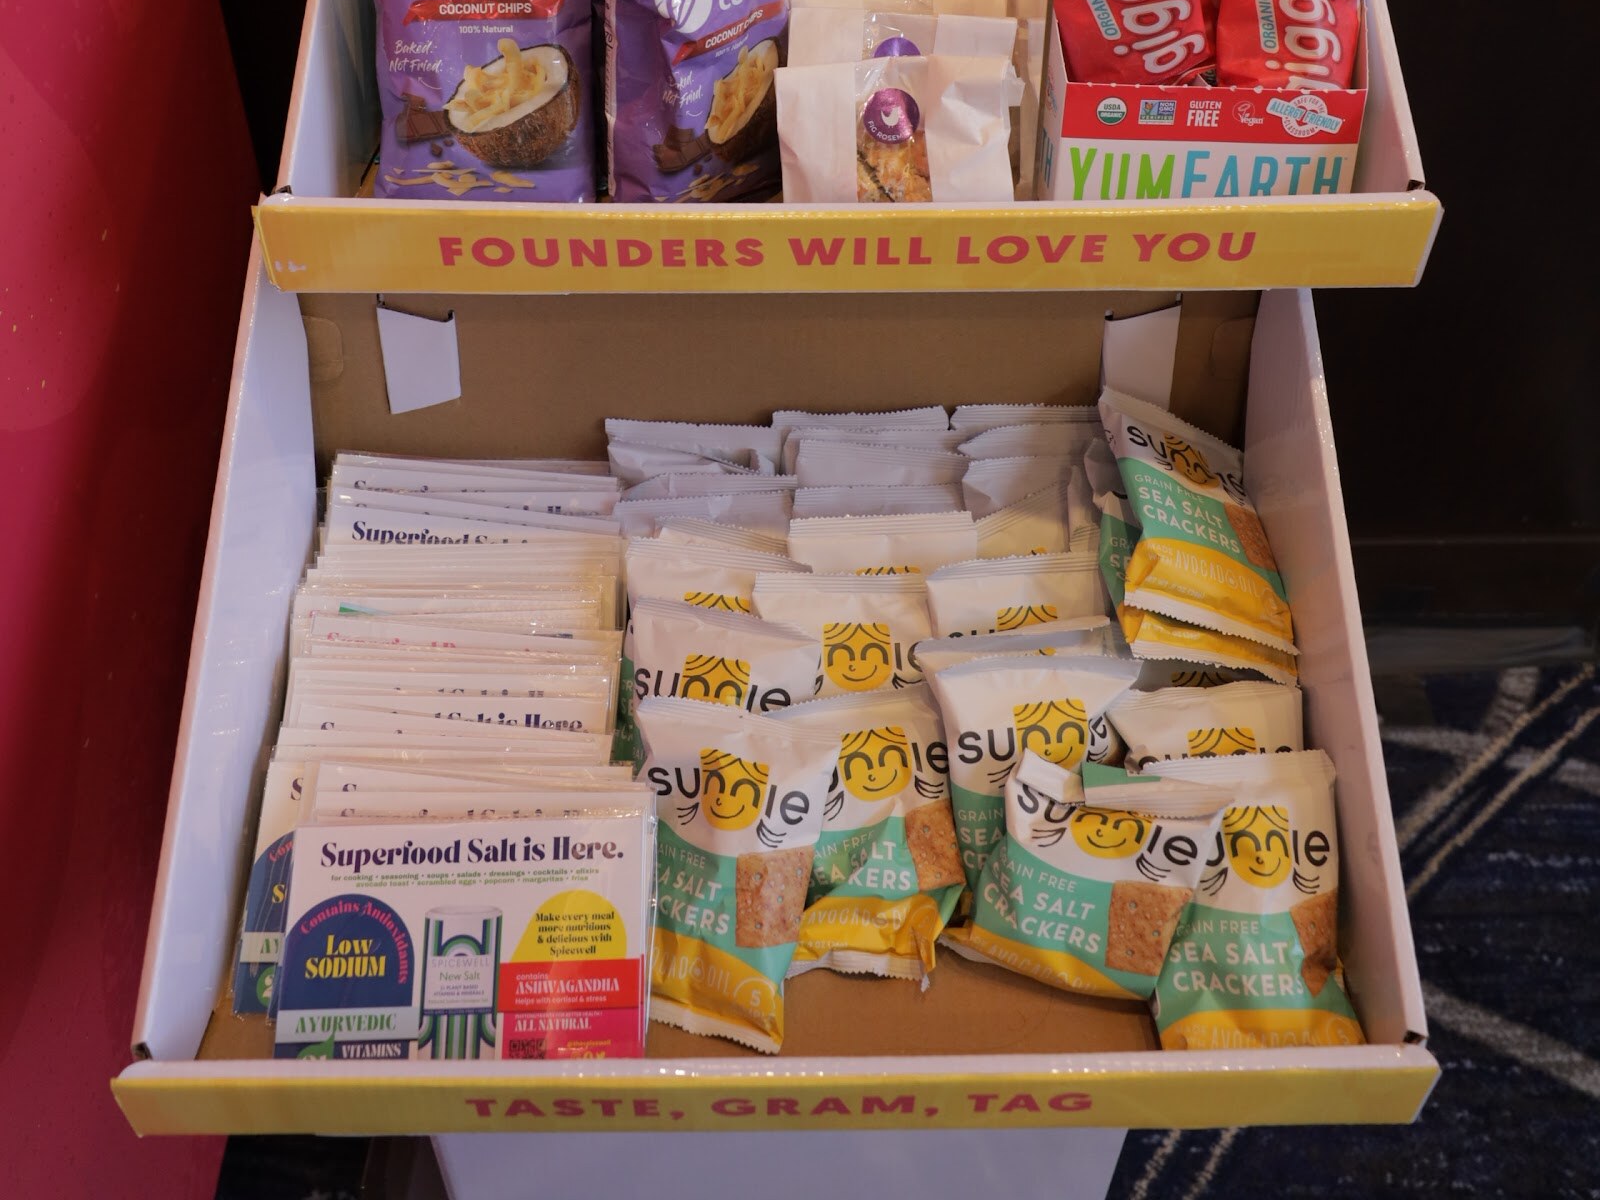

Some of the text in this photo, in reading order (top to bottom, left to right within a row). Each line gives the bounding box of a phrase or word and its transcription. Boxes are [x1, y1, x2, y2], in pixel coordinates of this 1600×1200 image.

[438, 3, 532, 15] COCONUT CHIPS
[459, 25, 514, 34] 100% Natural
[705, 24, 743, 49] COCONUT
[389, 59, 410, 72] Not
[1189, 100, 1222, 110] GLUTEN
[1186, 109, 1220, 127] FREE
[1269, 101, 1340, 131] ALLERGY FRIENDLY
[867, 120, 878, 133] FIG
[1069, 147, 1343, 201] YUMEARTH
[438, 231, 1257, 268] FOUNDERS WILL LOVE YOU
[1134, 474, 1172, 492] GRAIN
[1138, 486, 1223, 529] SEA SALT
[1142, 504, 1241, 554] CRACKERS
[647, 766, 811, 826] sunnie
[957, 809, 1003, 822] GRAIN
[960, 826, 1003, 847] SEA
[319, 839, 461, 874] Superfood
[466, 837, 518, 864] Salt
[522, 836, 546, 862] is
[552, 835, 625, 861] Here.
[658, 843, 706, 869] AIN FREE
[814, 843, 837, 859] AIN
[343, 874, 373, 882] cooking
[380, 873, 419, 881] seasoning
[426, 872, 449, 880] soups
[532, 868, 568, 876] cocktails
[483, 877, 515, 885] popcorn
[1038, 872, 1077, 893] FREE
[672, 870, 722, 902] SALT
[660, 895, 731, 935] CKERS
[1033, 892, 1096, 921] SALT
[535, 911, 615, 922] Make every meal
[983, 882, 1102, 954] CRACKERS
[538, 924, 563, 933] more
[1219, 919, 1259, 934] FREE
[300, 900, 410, 985] Contains Antioxidants
[537, 933, 612, 944] & delicious with
[550, 945, 597, 957] Spicewell
[1169, 942, 1288, 965] SEA SALT
[304, 955, 387, 980] SODIUM
[431, 957, 490, 968] SPICEWELL
[439, 971, 481, 980] New Salt
[516, 972, 548, 980] contains
[1172, 971, 1305, 997] CRACKERS
[516, 978, 620, 995] ASHWAGANDHA
[515, 997, 535, 1006] Helps
[536, 996, 551, 1005] with
[294, 1013, 397, 1034] AYURVEDIC
[514, 1017, 592, 1032] ALL NATURAL
[341, 1042, 402, 1059] VITAMINS
[465, 1091, 1094, 1120] TASTE, GRAM, TAG
